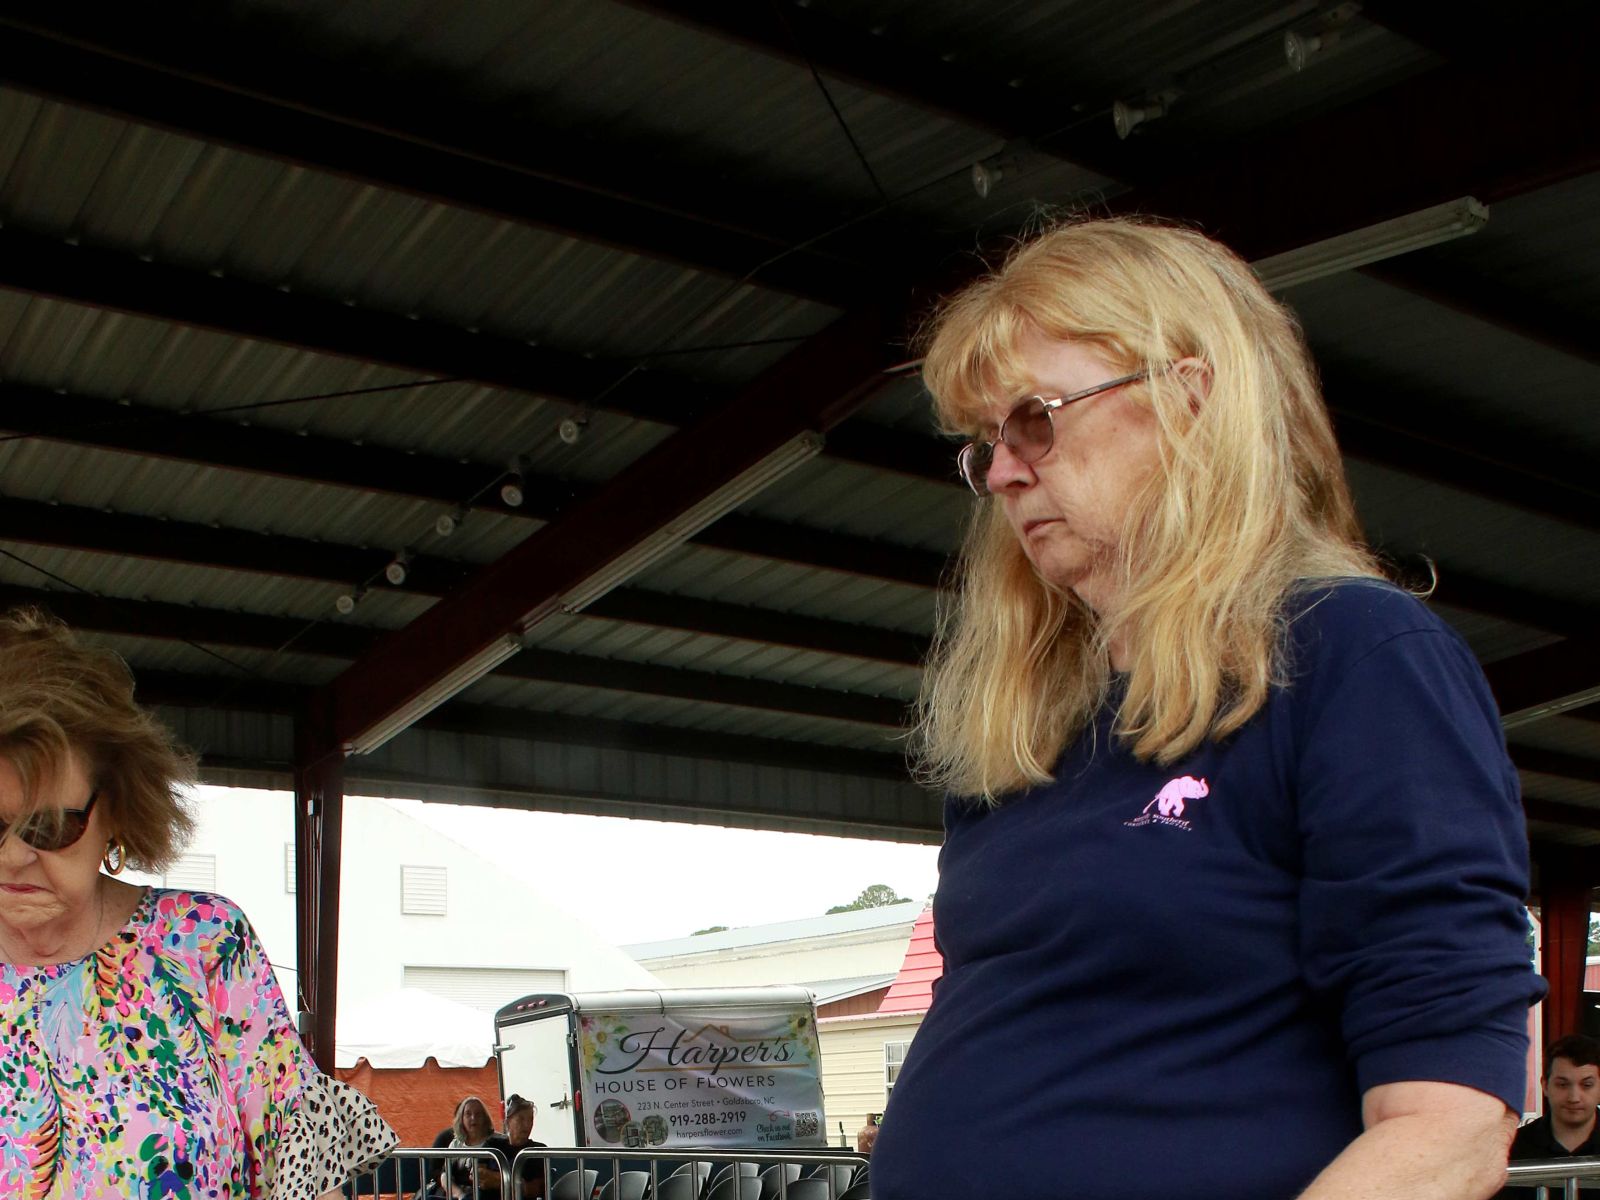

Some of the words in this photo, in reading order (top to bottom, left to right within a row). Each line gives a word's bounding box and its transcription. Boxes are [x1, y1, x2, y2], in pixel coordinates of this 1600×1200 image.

[595, 1026, 795, 1075] Harper's
[595, 1079, 656, 1094] HOUSE
[664, 1077, 688, 1090] OF
[697, 1075, 776, 1089] FLOWERS
[637, 1102, 651, 1111] 223
[664, 1101, 690, 1109] Center
[691, 1100, 714, 1108] Street
[763, 1097, 776, 1105] NC
[669, 1111, 747, 1127] 919-288-2919
[676, 1127, 743, 1139] harpersflower.com
